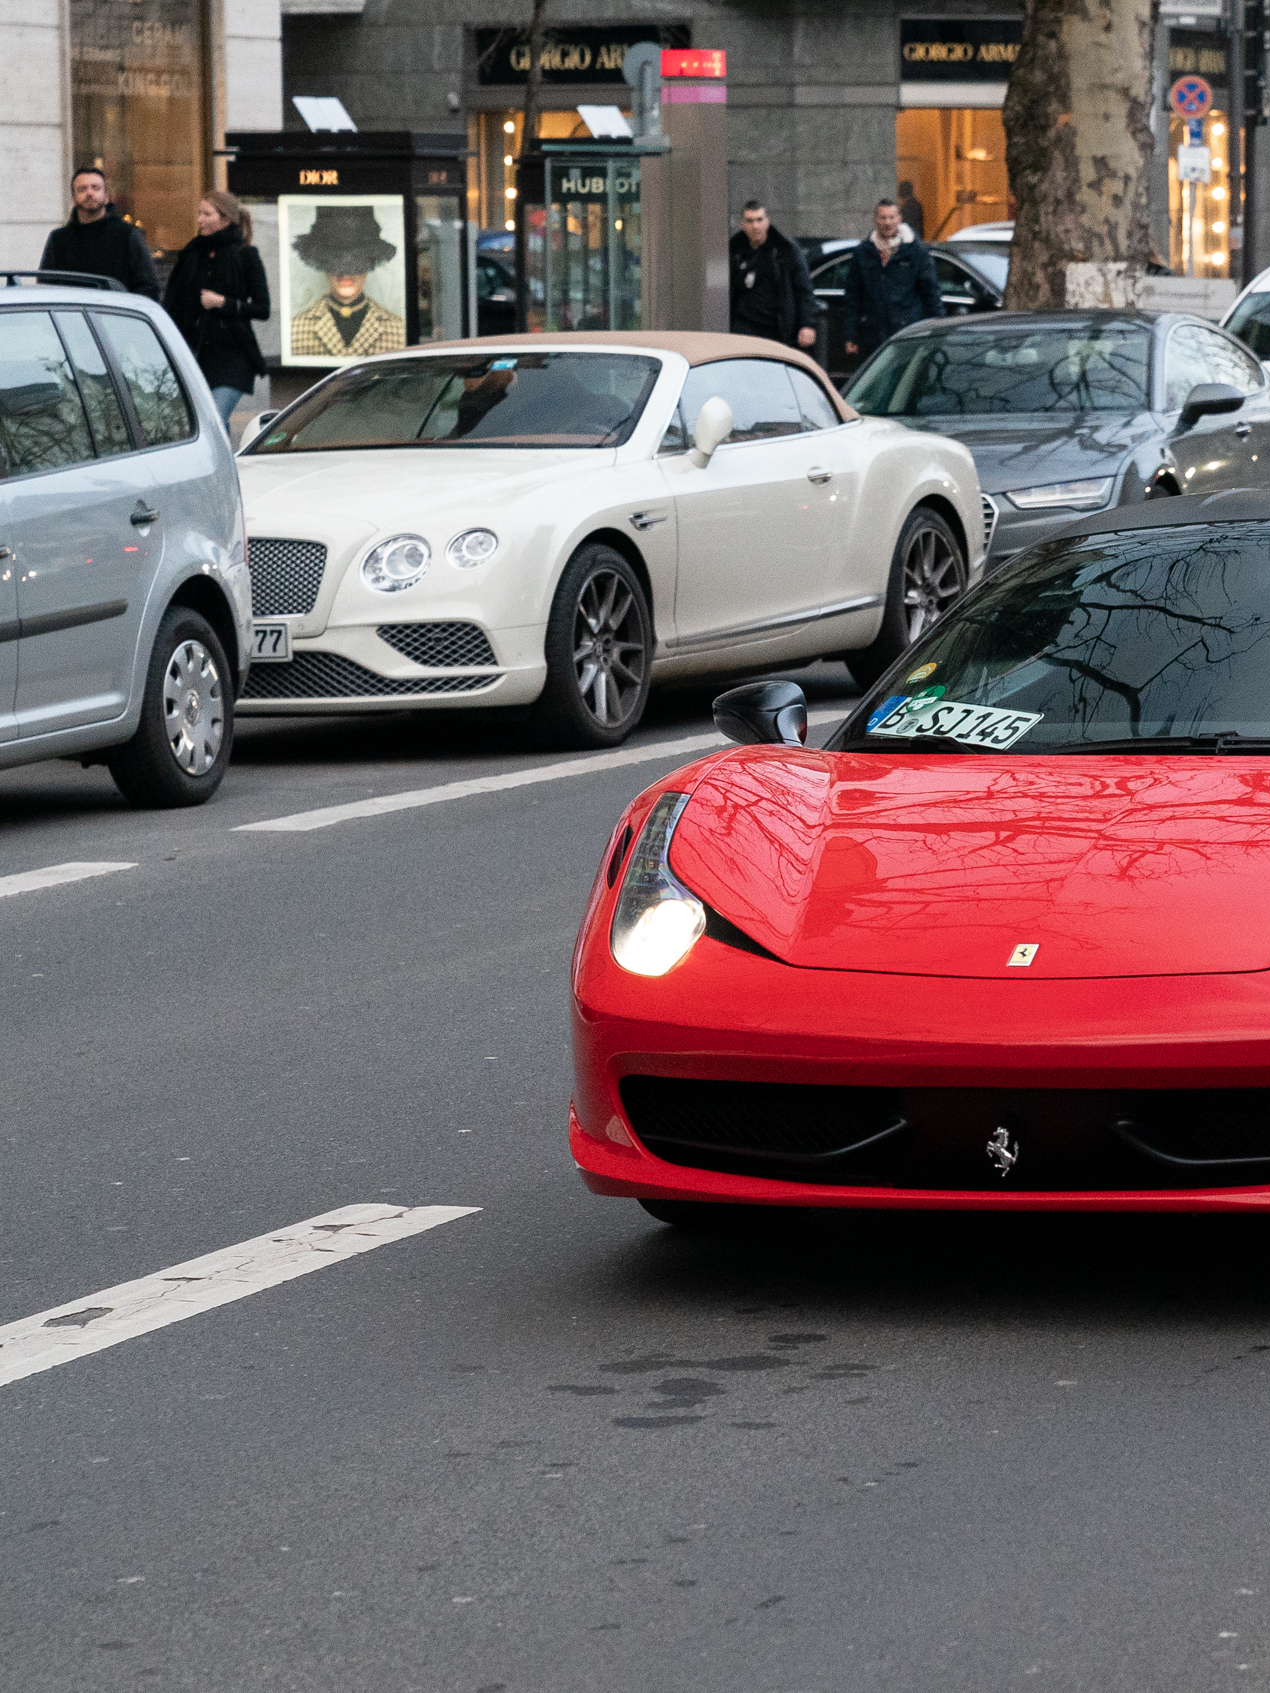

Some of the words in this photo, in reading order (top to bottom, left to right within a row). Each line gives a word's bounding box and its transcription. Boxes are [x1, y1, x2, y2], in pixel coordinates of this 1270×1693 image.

[903, 42, 974, 62] GIORGIO
[299, 168, 338, 187] DIOR
[254, 629, 282, 654] 77
